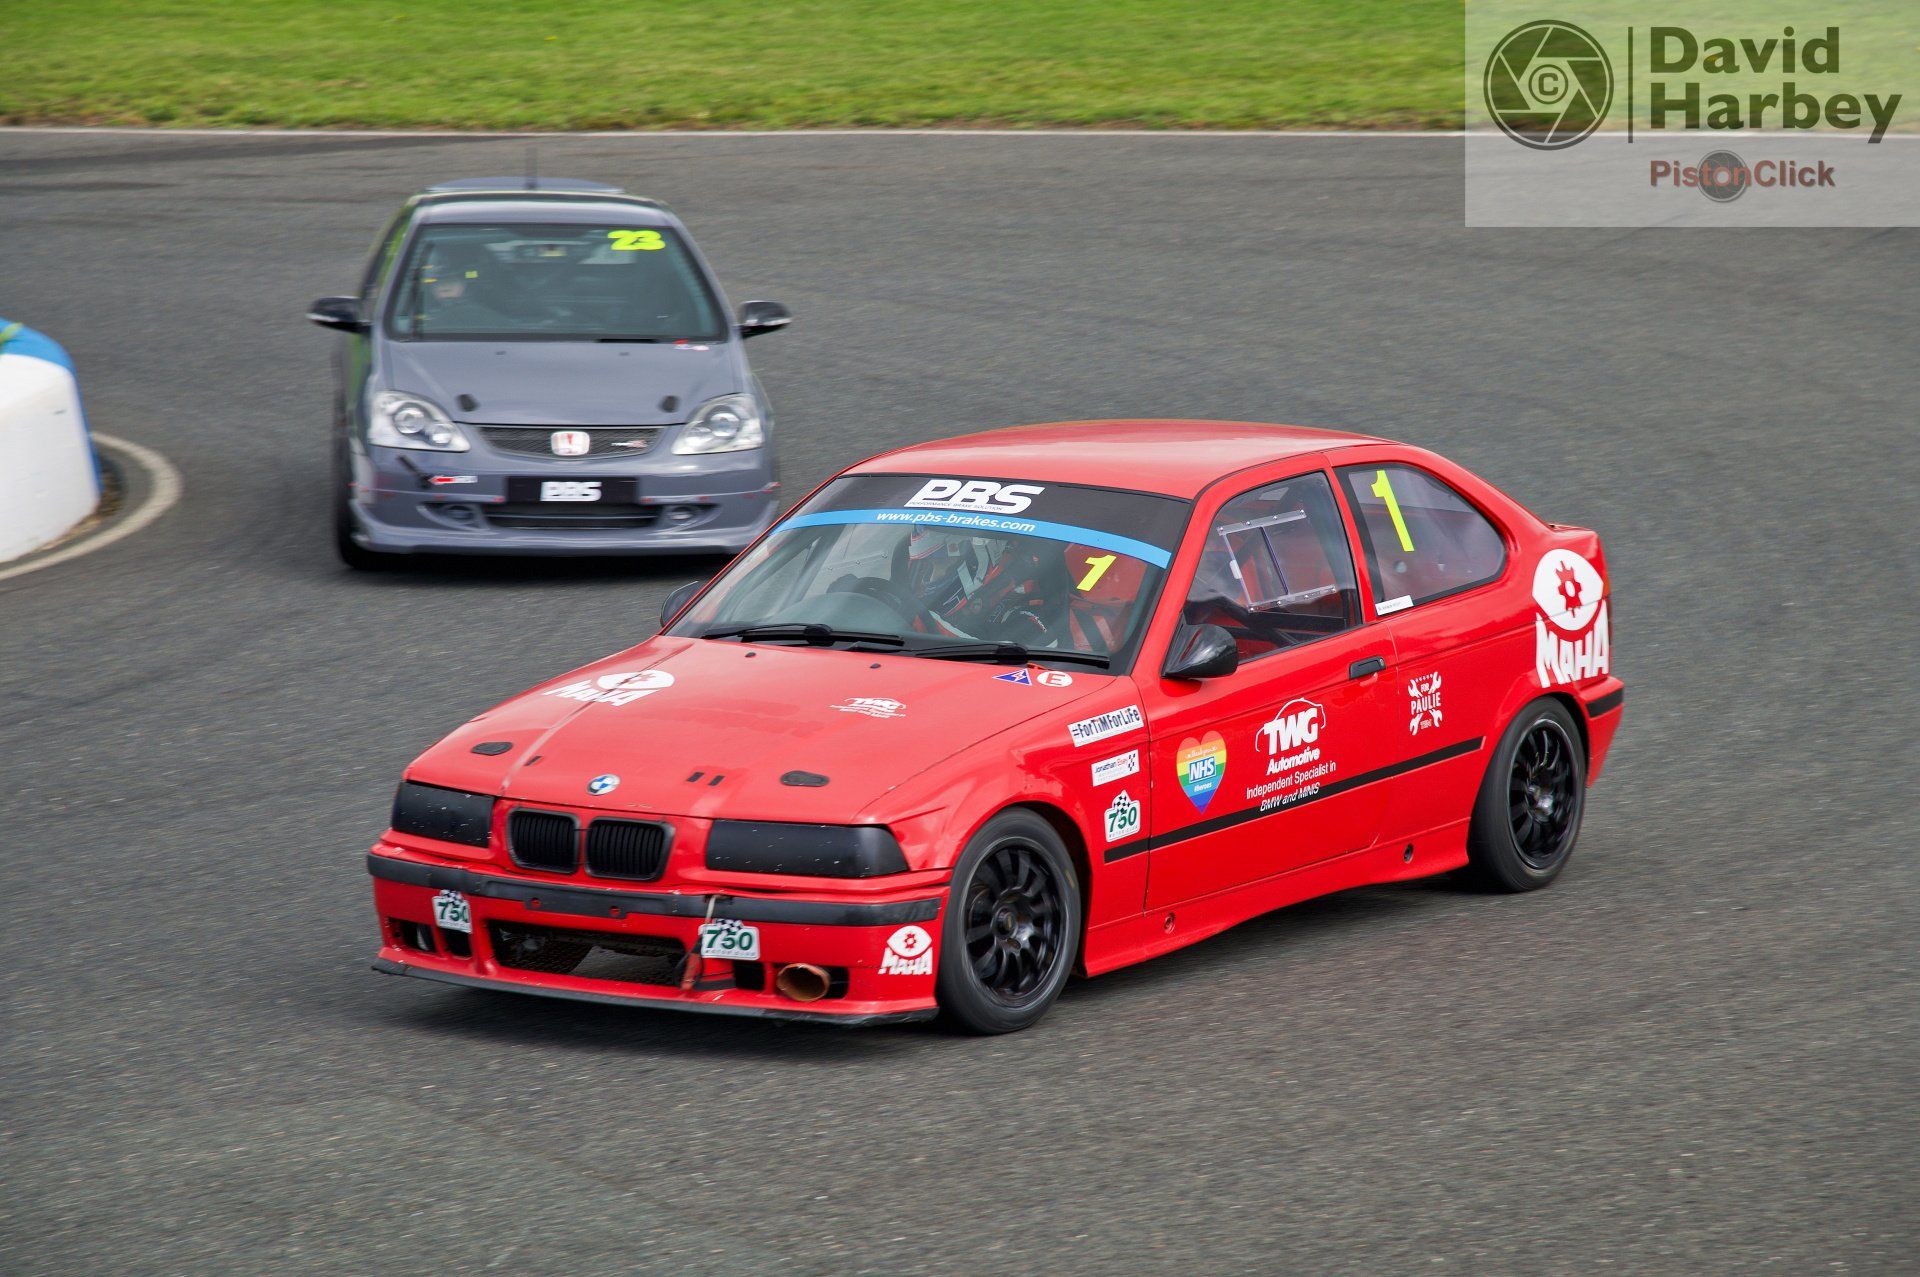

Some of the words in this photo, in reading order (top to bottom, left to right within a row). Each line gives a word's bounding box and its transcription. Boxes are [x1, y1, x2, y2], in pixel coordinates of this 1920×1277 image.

[608, 230, 666, 250] 23
[540, 481, 602, 501] PBS
[904, 479, 1046, 514] PBS
[876, 512, 1036, 532] www.pbs-brakes.com
[1370, 469, 1415, 552] 1
[1076, 554, 1117, 592] 1
[1410, 692, 1441, 715] PAULIE
[1263, 707, 1319, 756] TWG
[1190, 758, 1215, 781] NHS
[1266, 746, 1321, 776] Automotive
[1246, 775, 1293, 800] Independent
[1294, 763, 1329, 785] Specialist
[1330, 760, 1336, 773] in
[1260, 794, 1283, 812] BMW
[1282, 789, 1299, 805] and
[1108, 806, 1137, 833] 750
[707, 930, 752, 950] 750
